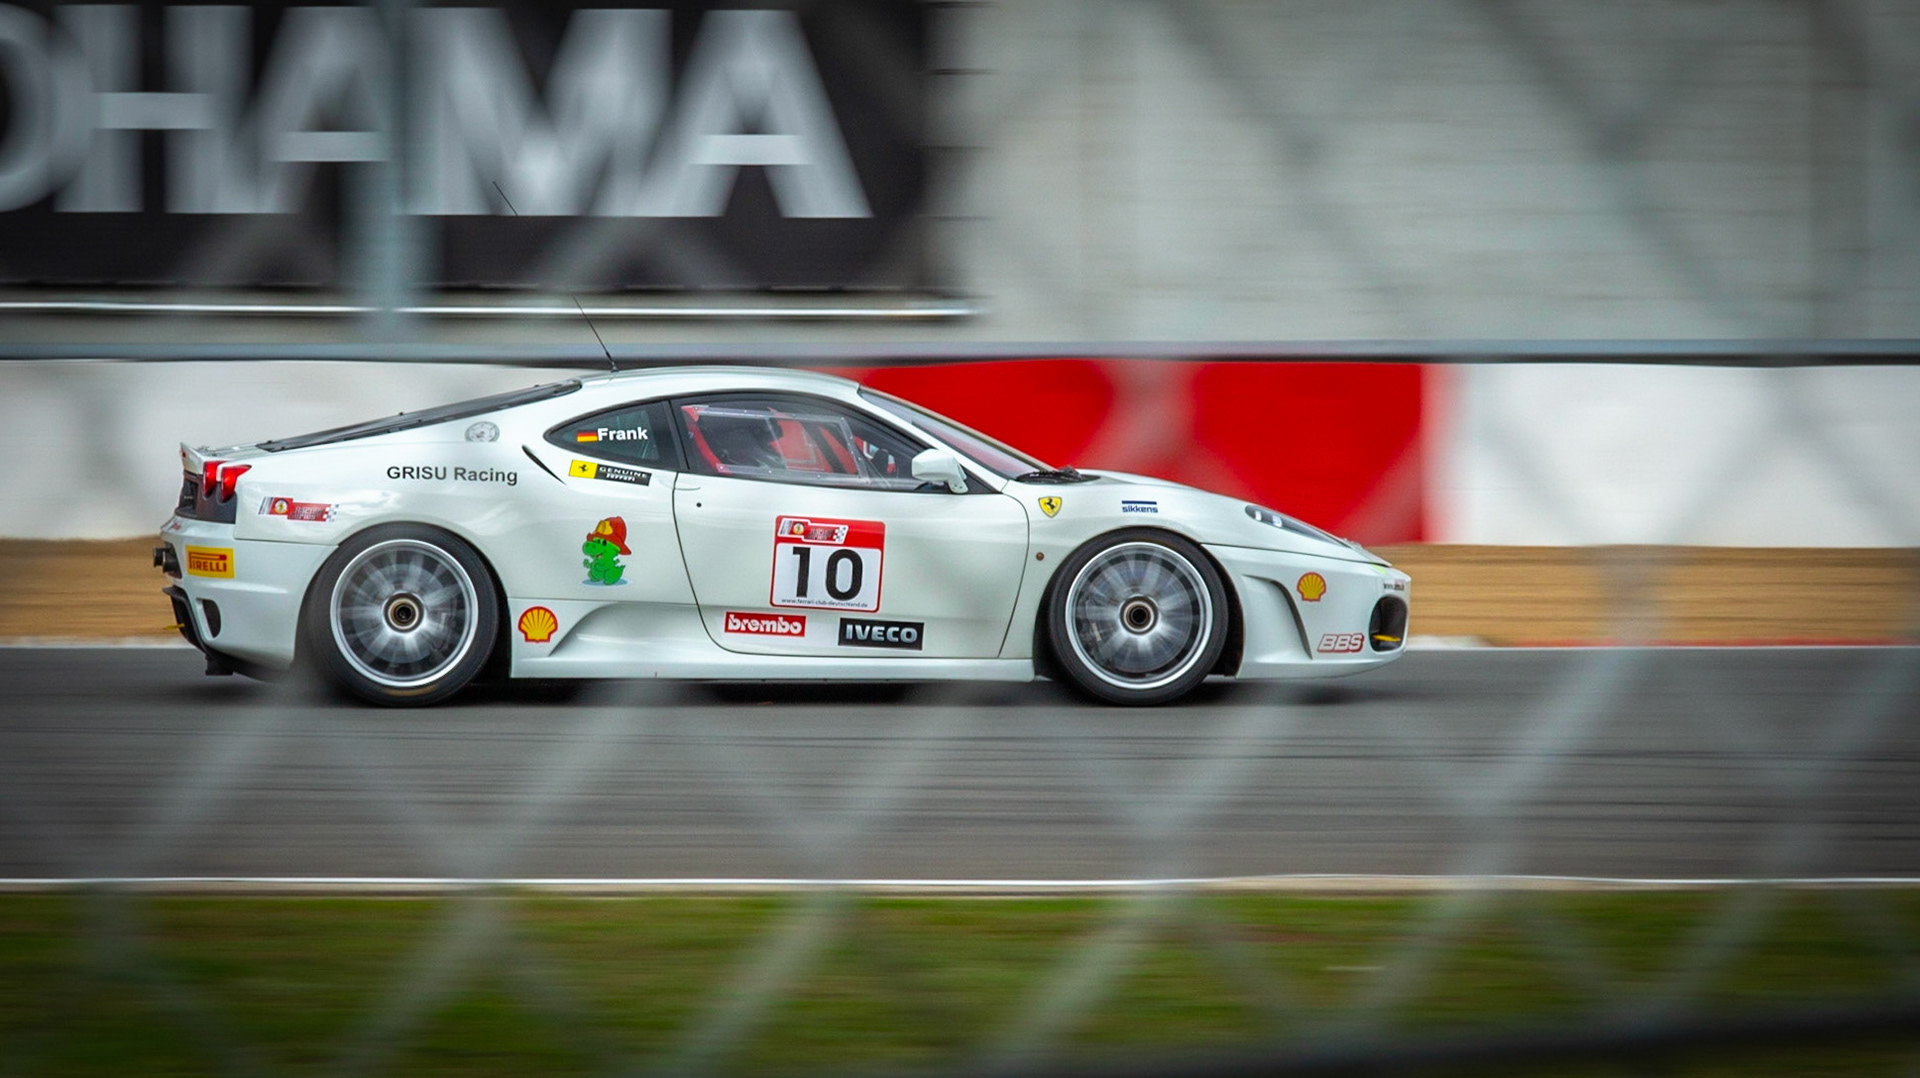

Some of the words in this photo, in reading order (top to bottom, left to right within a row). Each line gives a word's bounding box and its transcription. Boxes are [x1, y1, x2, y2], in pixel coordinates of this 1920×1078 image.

[597, 427, 648, 441] Frank
[386, 466, 447, 481] GRISU
[454, 467, 518, 486] Racing
[599, 466, 649, 478] GENUINE
[1122, 505, 1158, 513] sikkens
[188, 551, 227, 573] PIRELLI
[792, 546, 863, 601] 10
[727, 614, 802, 634] brembo
[845, 624, 919, 644] IVECO
[1317, 632, 1365, 653] BBS
